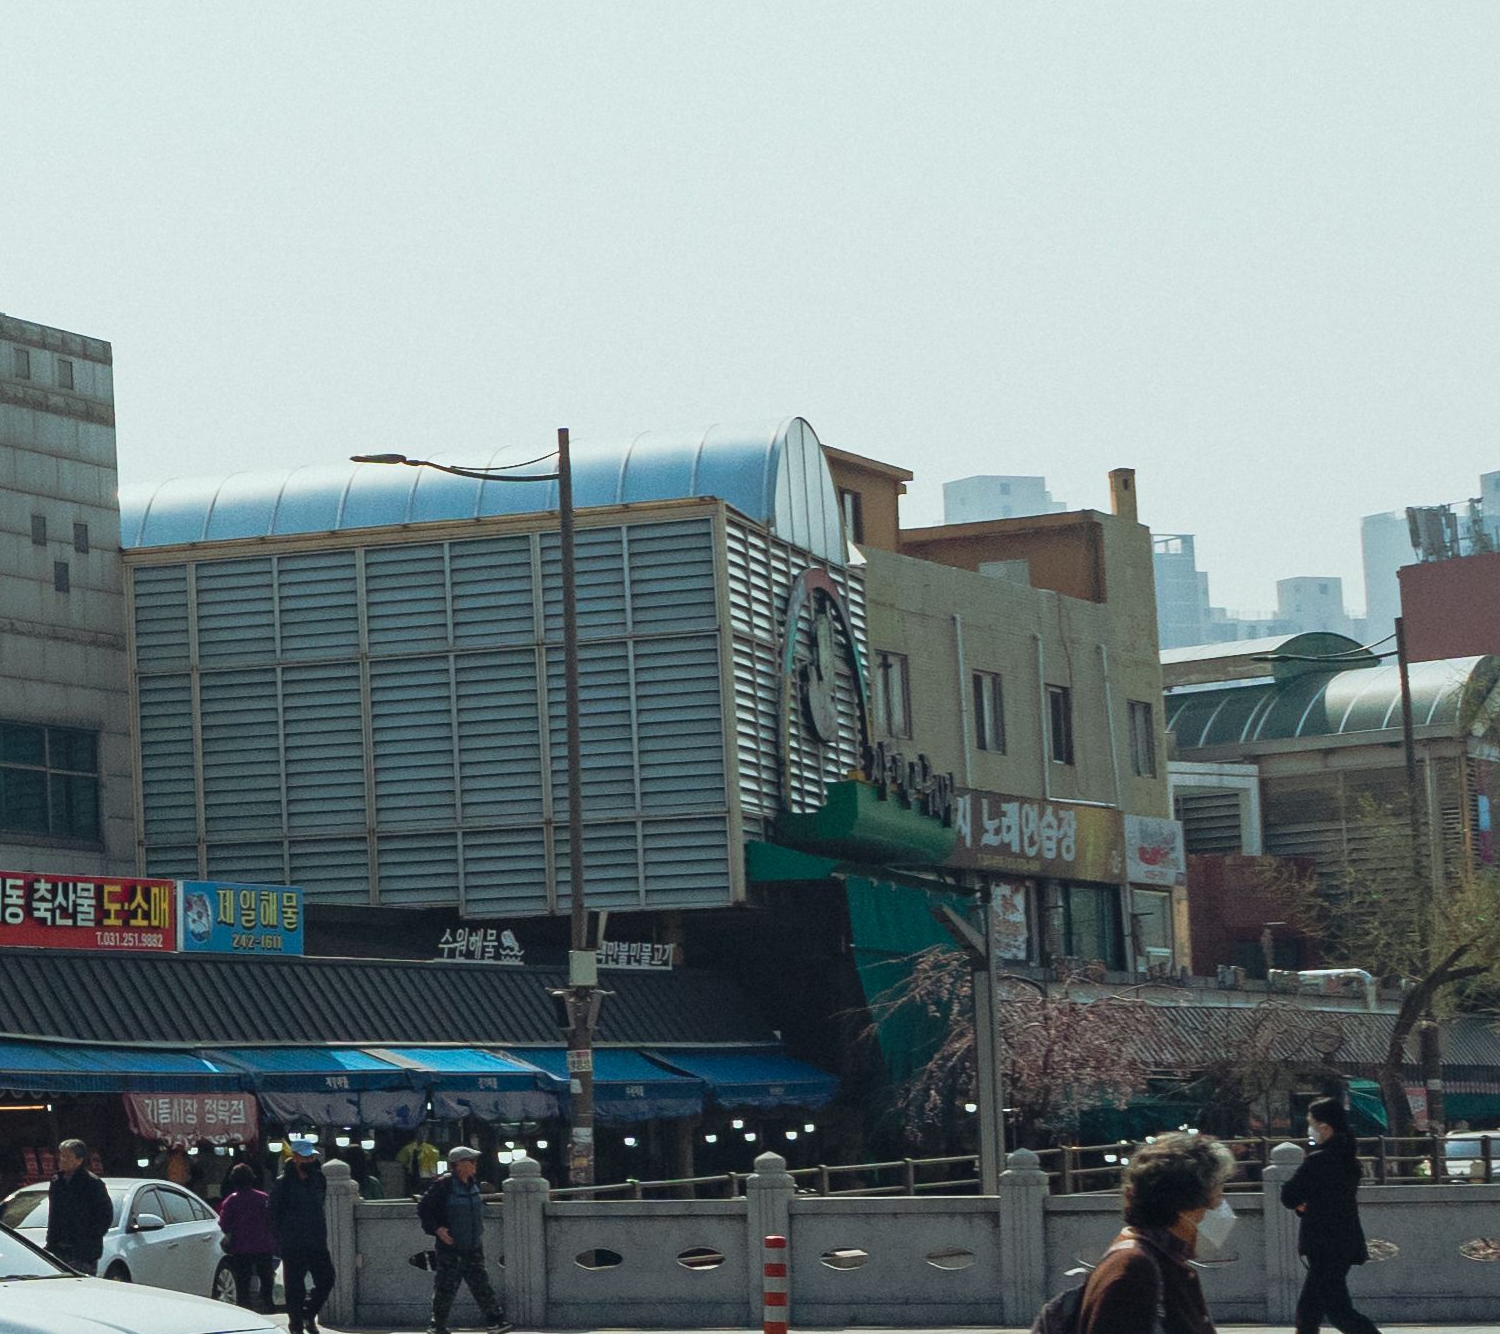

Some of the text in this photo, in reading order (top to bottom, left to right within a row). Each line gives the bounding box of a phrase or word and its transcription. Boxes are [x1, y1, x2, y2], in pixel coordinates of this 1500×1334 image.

[980, 796, 1078, 863] 노래연습장
[31, 879, 96, 927] 축산물
[102, 883, 170, 930] 도·소매
[216, 888, 299, 930] 제일해물
[438, 927, 500, 962] 수원해물
[203, 1098, 247, 1125] 정육점
